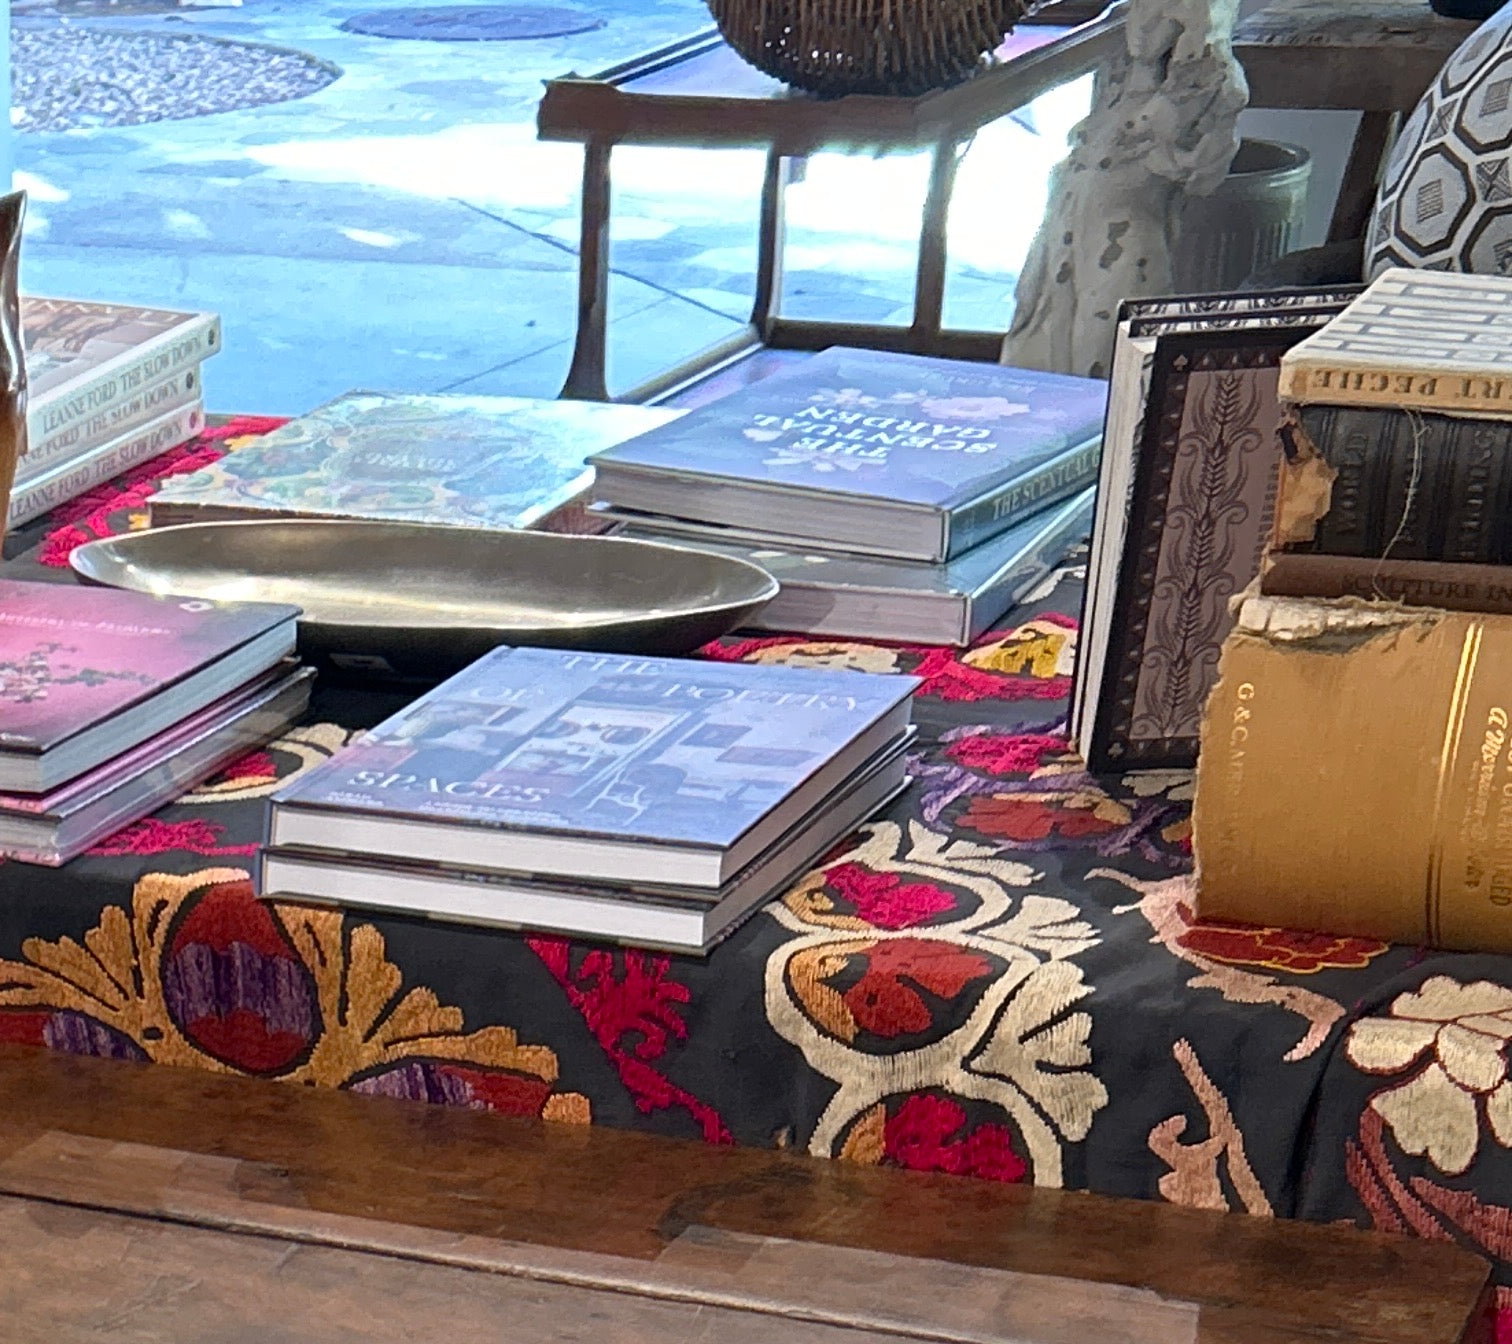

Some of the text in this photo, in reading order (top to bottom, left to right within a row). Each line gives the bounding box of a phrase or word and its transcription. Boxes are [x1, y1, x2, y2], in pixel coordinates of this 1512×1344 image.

[43, 337, 202, 434] LEANNE FORD THE SLOW DOWN
[46, 378, 179, 455] FORD THE SLOW DOWN
[753, 413, 997, 454] SCENTUAL
[796, 405, 992, 440] GARDEN
[792, 437, 889, 459] THE
[10, 420, 182, 520] LEANNE FORD THE SLOW DOWN
[993, 490, 1020, 521] THE
[1023, 452, 1089, 503] SCENTUAL
[562, 655, 667, 675] THE
[470, 684, 857, 711] OF POETRY
[347, 771, 550, 802] SPACES
